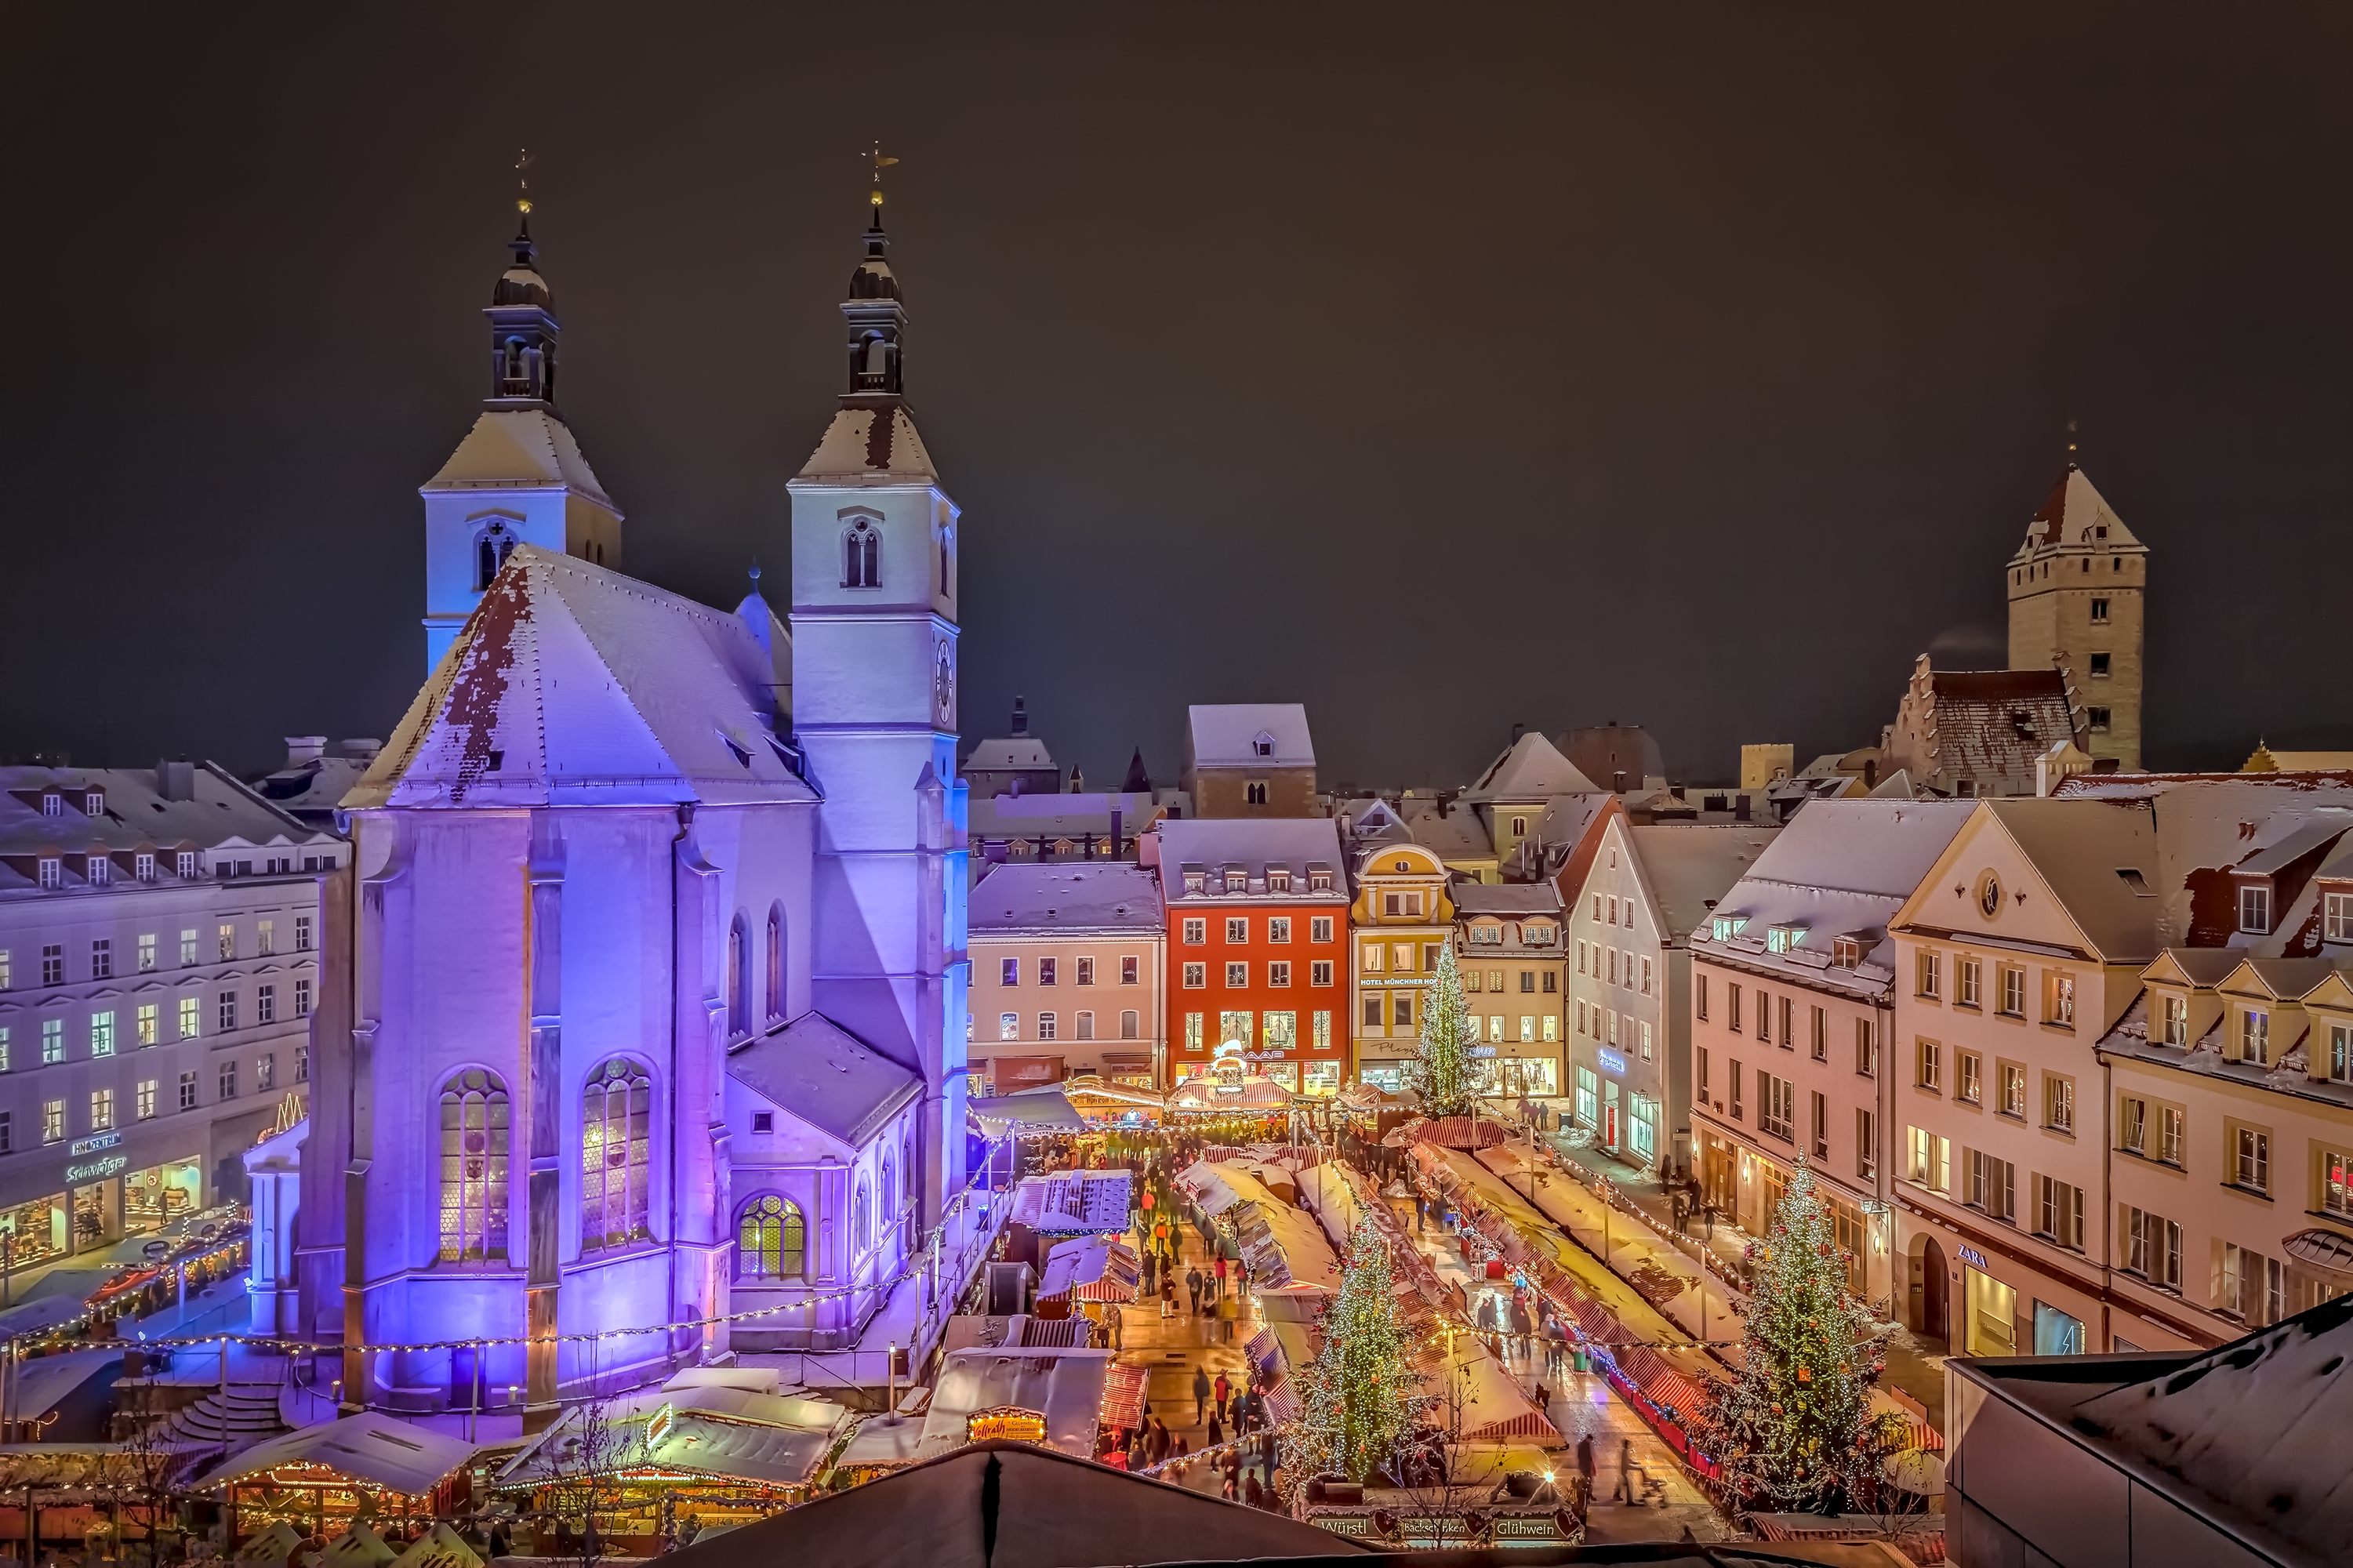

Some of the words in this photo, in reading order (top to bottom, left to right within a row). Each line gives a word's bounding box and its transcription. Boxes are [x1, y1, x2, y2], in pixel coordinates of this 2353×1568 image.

[1232, 1051, 1284, 1059] RAAB
[66, 1157, 127, 1183] Schwaiger
[1958, 1243, 1988, 1269] ZARA
[973, 1419, 1006, 1438] Vollrath
[1321, 1519, 1367, 1534] Würstl
[1404, 1520, 1465, 1533] Backschnken
[1497, 1521, 1554, 1535] Glühwein
